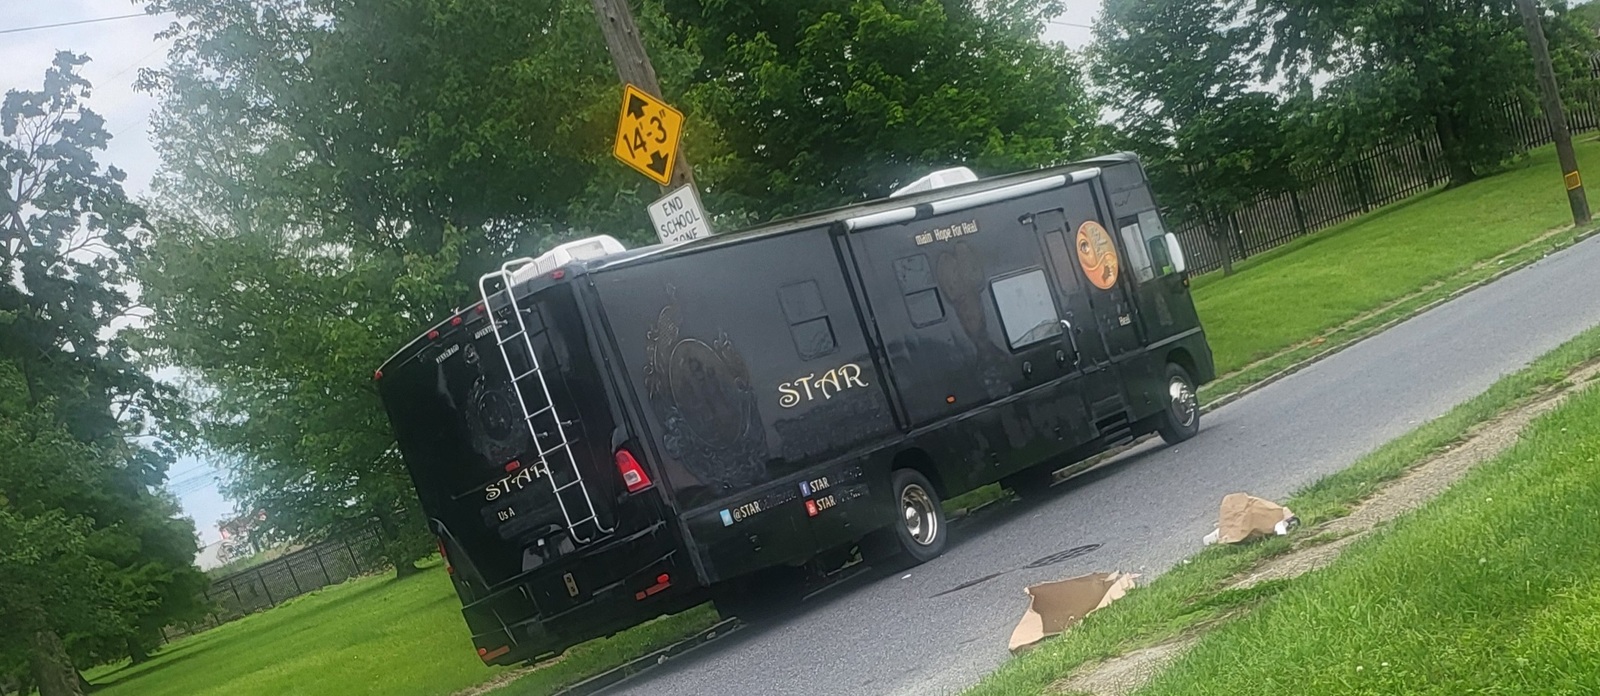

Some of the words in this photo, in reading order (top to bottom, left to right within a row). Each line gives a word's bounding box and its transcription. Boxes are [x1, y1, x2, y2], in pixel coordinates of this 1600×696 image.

[662, 196, 683, 217] END
[660, 208, 700, 238] SCHOOL
[933, 228, 953, 242] Hope
[951, 225, 963, 237] For
[778, 363, 869, 408] STAR
[485, 460, 554, 501] STAR
[809, 476, 830, 493] STAR
[732, 500, 762, 522] @STAR
[816, 494, 836, 511] STAR
